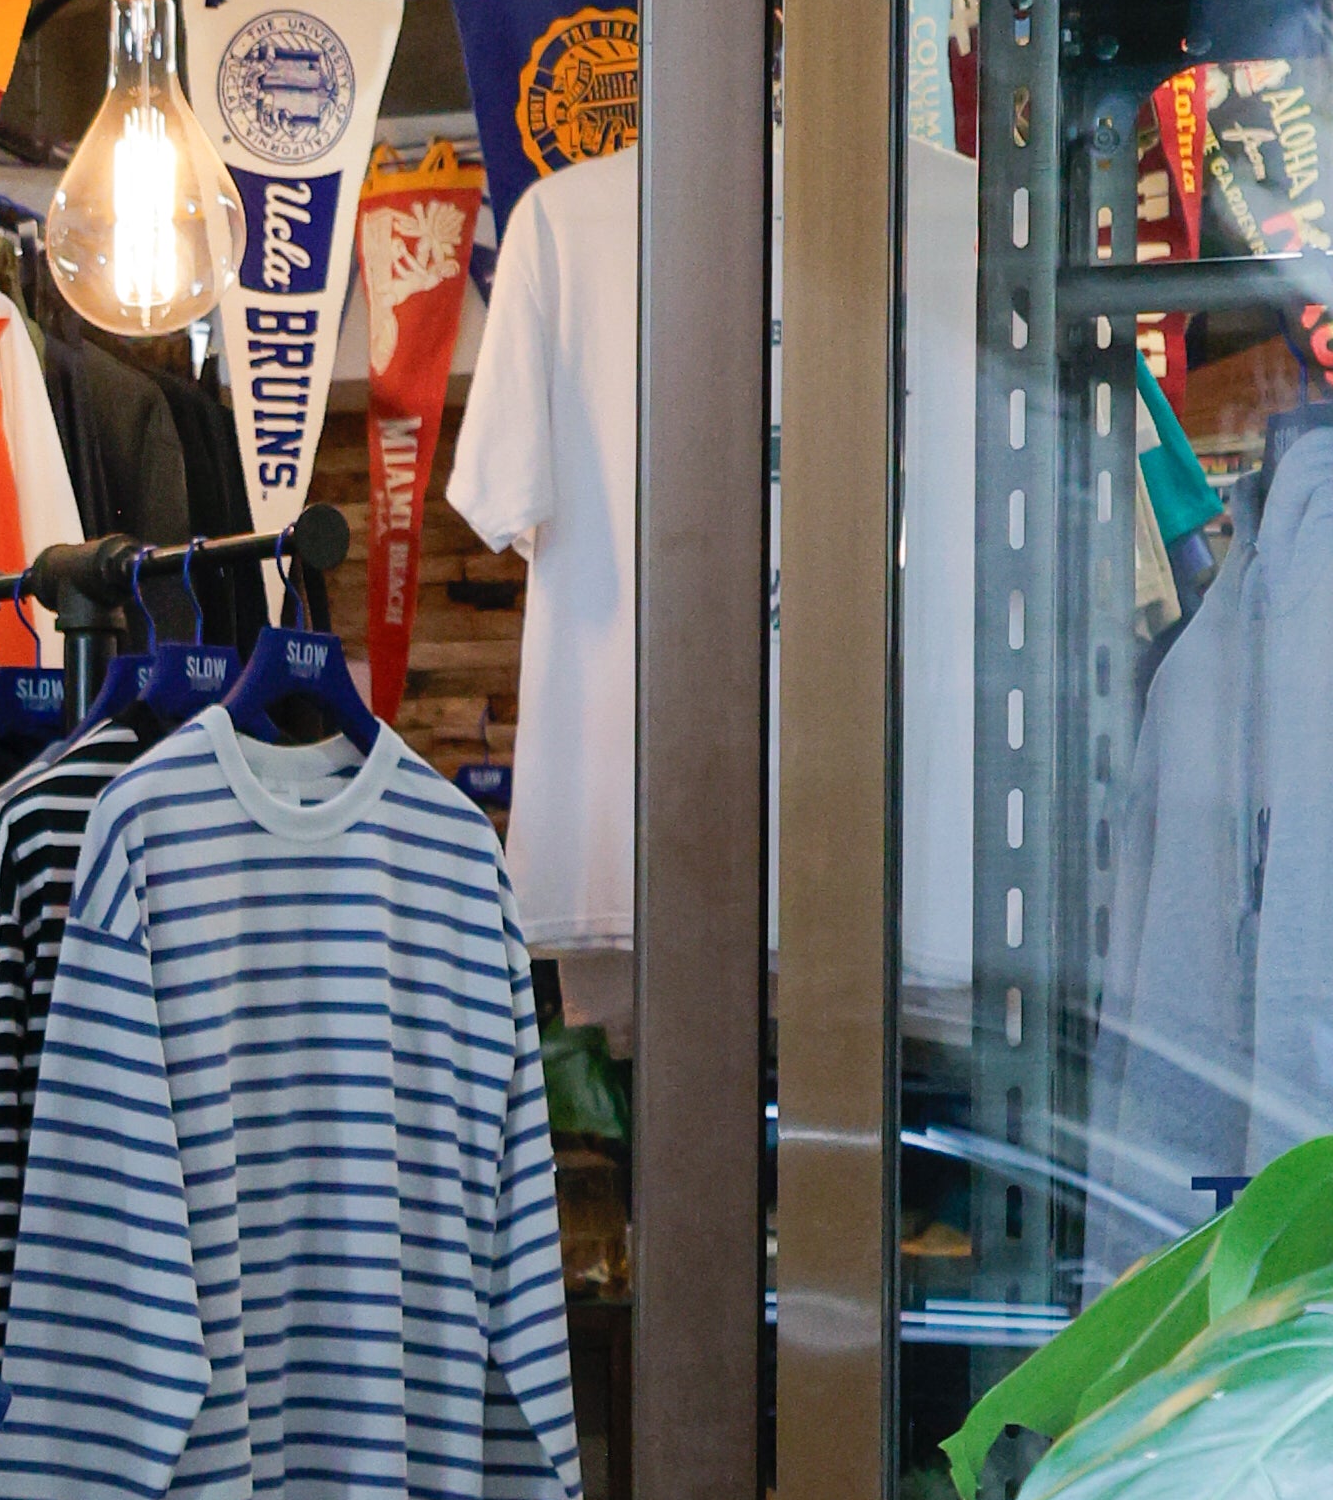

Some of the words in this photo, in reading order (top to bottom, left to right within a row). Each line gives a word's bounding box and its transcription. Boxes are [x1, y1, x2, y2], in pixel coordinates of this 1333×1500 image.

[247, 18, 274, 41] THE
[288, 18, 351, 89] UNIVERSITY
[1262, 86, 1319, 200] ALOHA
[263, 181, 313, 290] Ucla
[244, 307, 318, 492] BRUINS
[376, 415, 423, 530] MIAMI
[16, 677, 65, 701] SLOW
[185, 654, 227, 677] SLOW
[286, 640, 329, 668] SLOW
